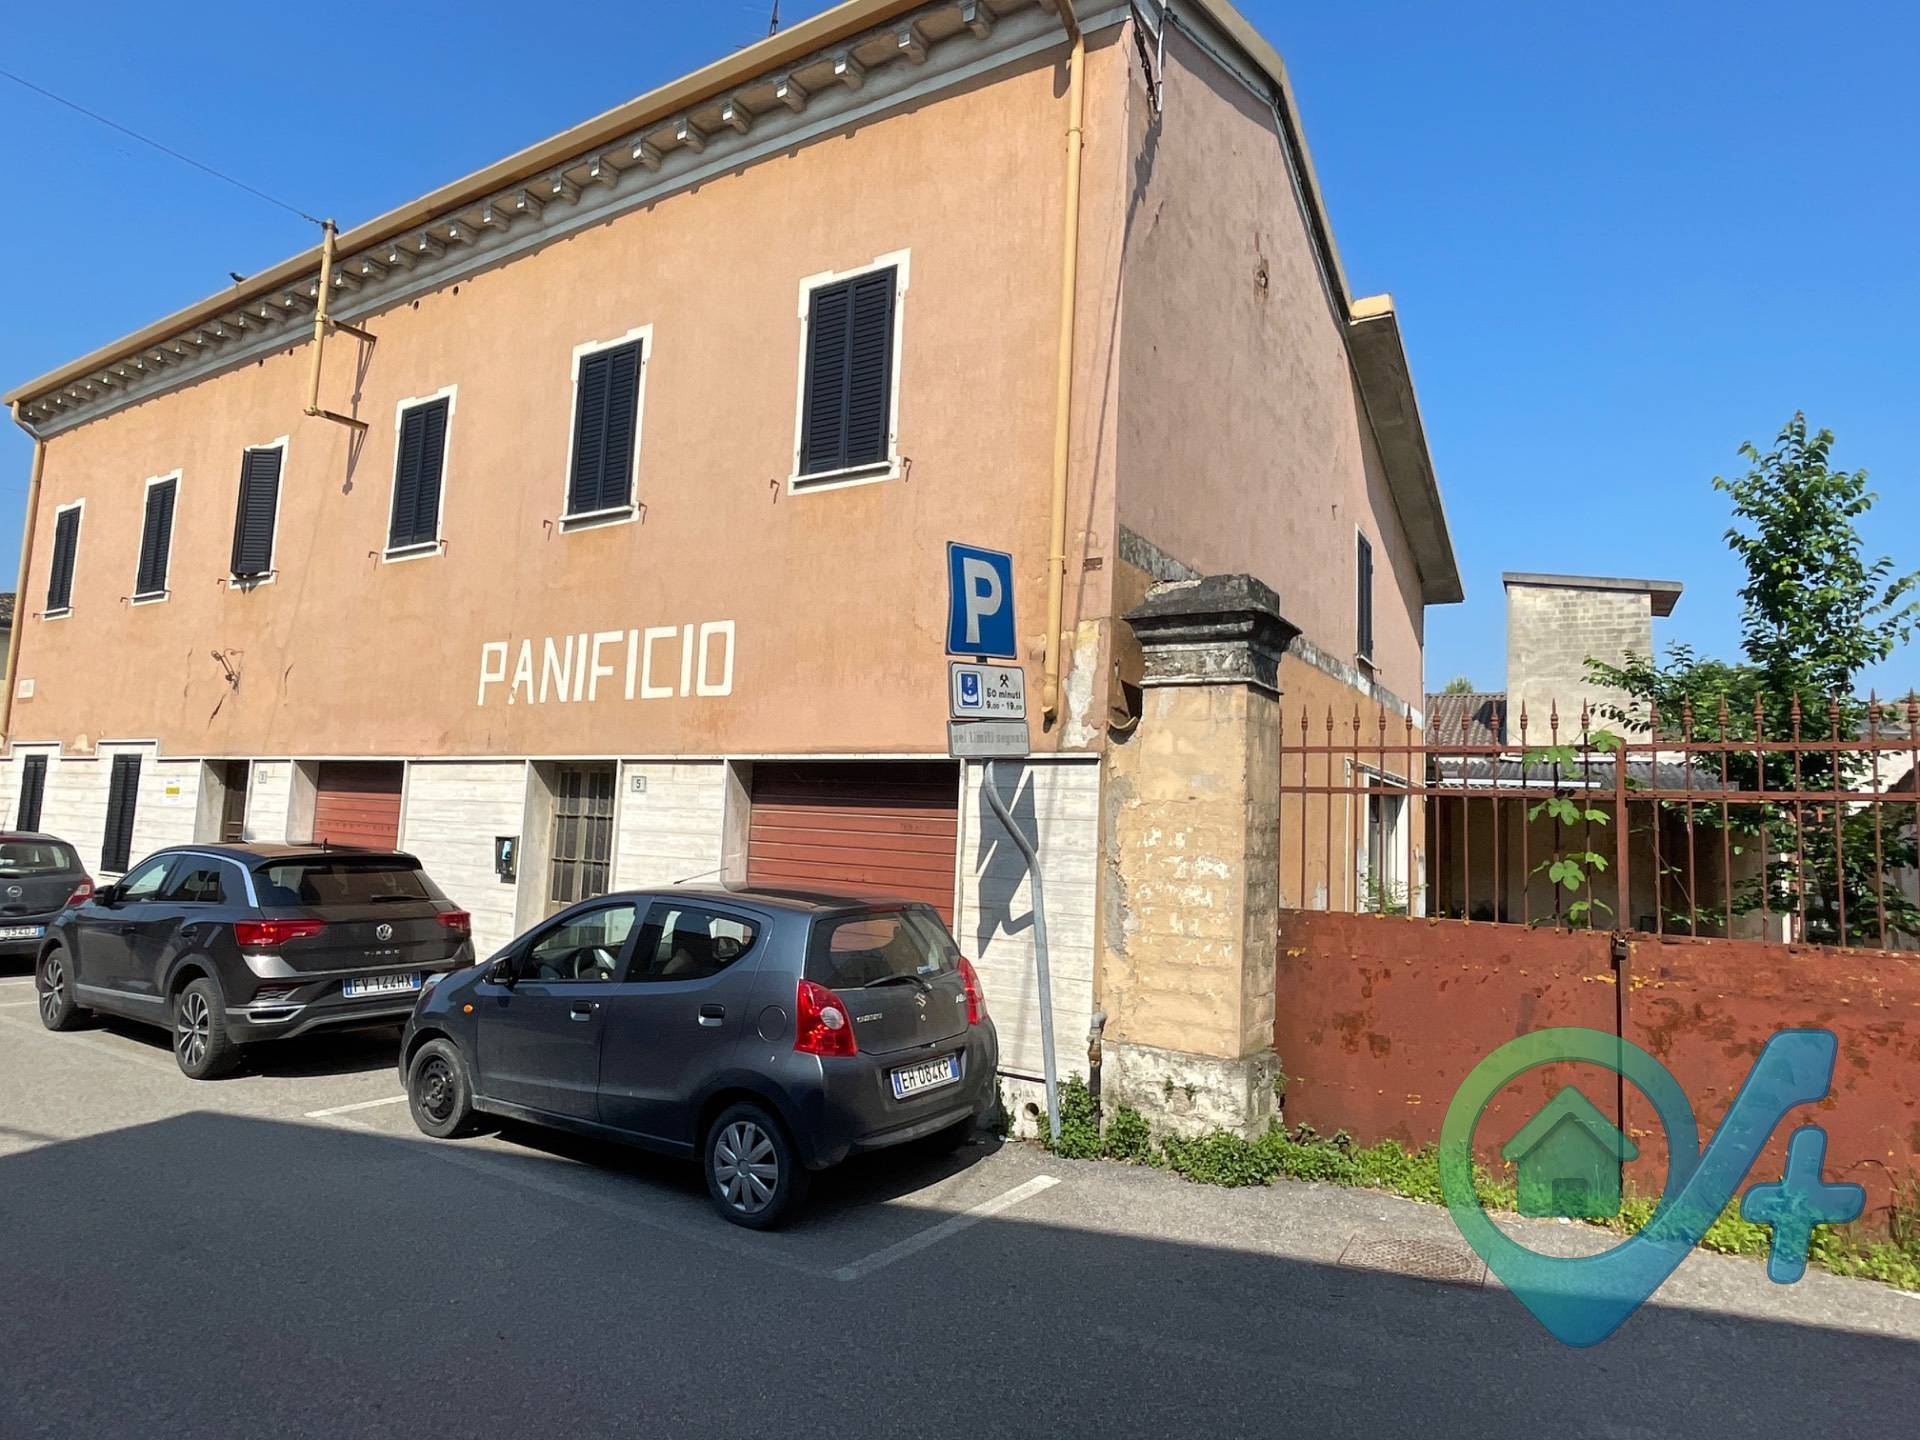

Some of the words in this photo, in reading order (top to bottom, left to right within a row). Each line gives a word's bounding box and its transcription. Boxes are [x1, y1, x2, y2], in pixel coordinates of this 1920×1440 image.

[963, 557, 1002, 644] P
[476, 619, 736, 706] PANIFICIO
[998, 690, 1021, 700] minuti
[636, 778, 641, 789] 5
[353, 978, 369, 992] FV
[901, 1068, 917, 1090] EH
[918, 1059, 949, 1085] 084KP
